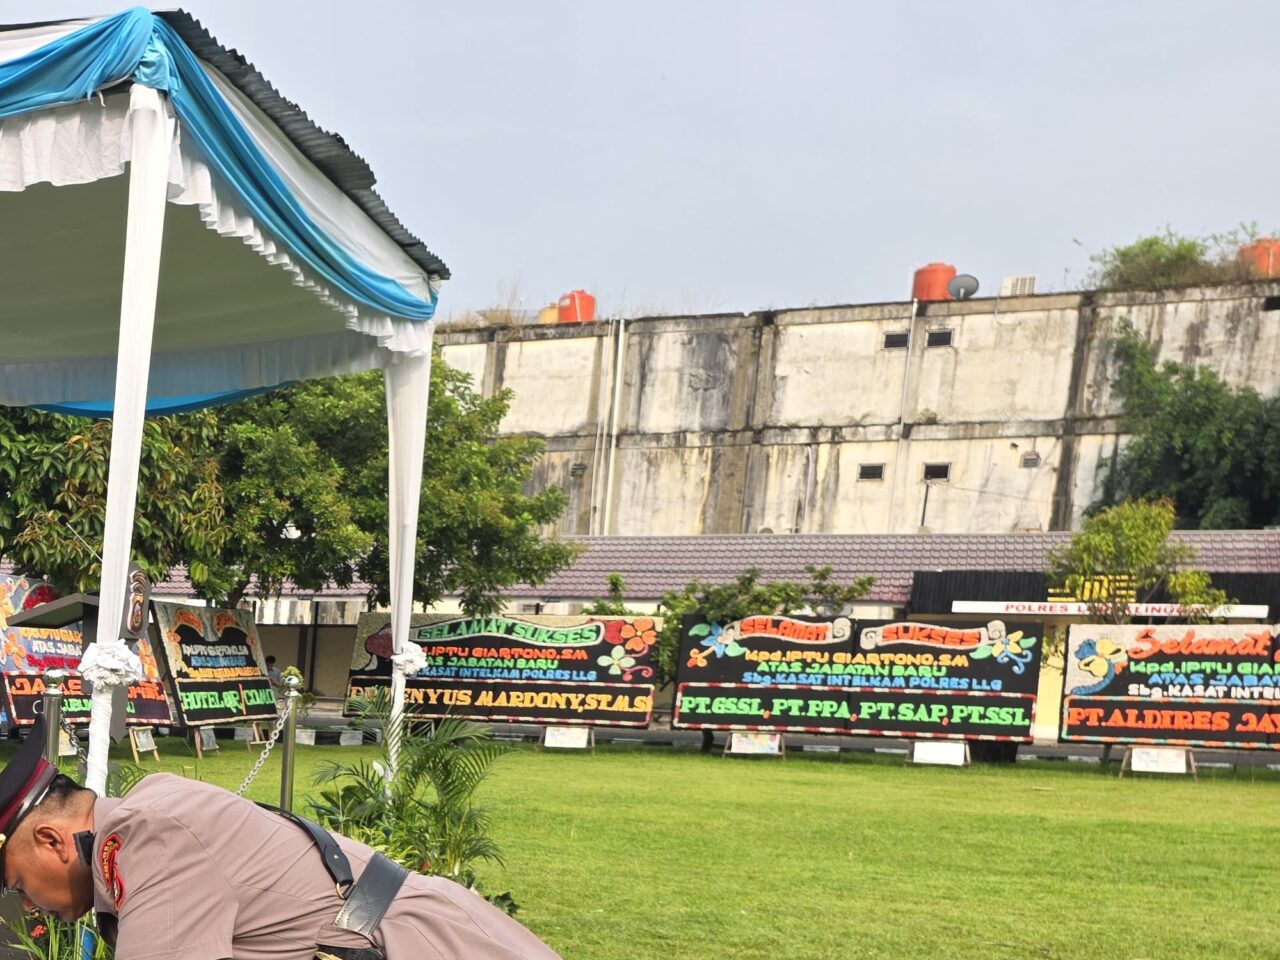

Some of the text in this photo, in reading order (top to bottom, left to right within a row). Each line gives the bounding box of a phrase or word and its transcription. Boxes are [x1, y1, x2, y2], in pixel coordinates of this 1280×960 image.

[1004, 603, 1069, 613] POLRES
[419, 617, 598, 645] SELAMAT SUKSES
[740, 617, 981, 646] SELAMAT SUKSES
[32, 640, 56, 654] ATAS
[1128, 628, 1271, 660] Selamat
[447, 658, 514, 669] JABATAN
[516, 659, 559, 670] BARU
[745, 650, 829, 663] Kpd.IPTU
[459, 668, 519, 679] INTELKAM
[521, 669, 570, 681] POLRES
[572, 671, 597, 681] LLG
[756, 661, 947, 678] ATAS JABATAN BARU
[1129, 661, 1233, 675] Kpd.IPTU
[742, 672, 1002, 691] Sbg.KASAT INTELKAM POLRES LLG
[1148, 673, 1205, 686] ATAS
[179, 691, 224, 710] HOTEL
[1128, 683, 1228, 701] Sbg.KASAT
[1067, 707, 1231, 731] PT.ALDIRES
